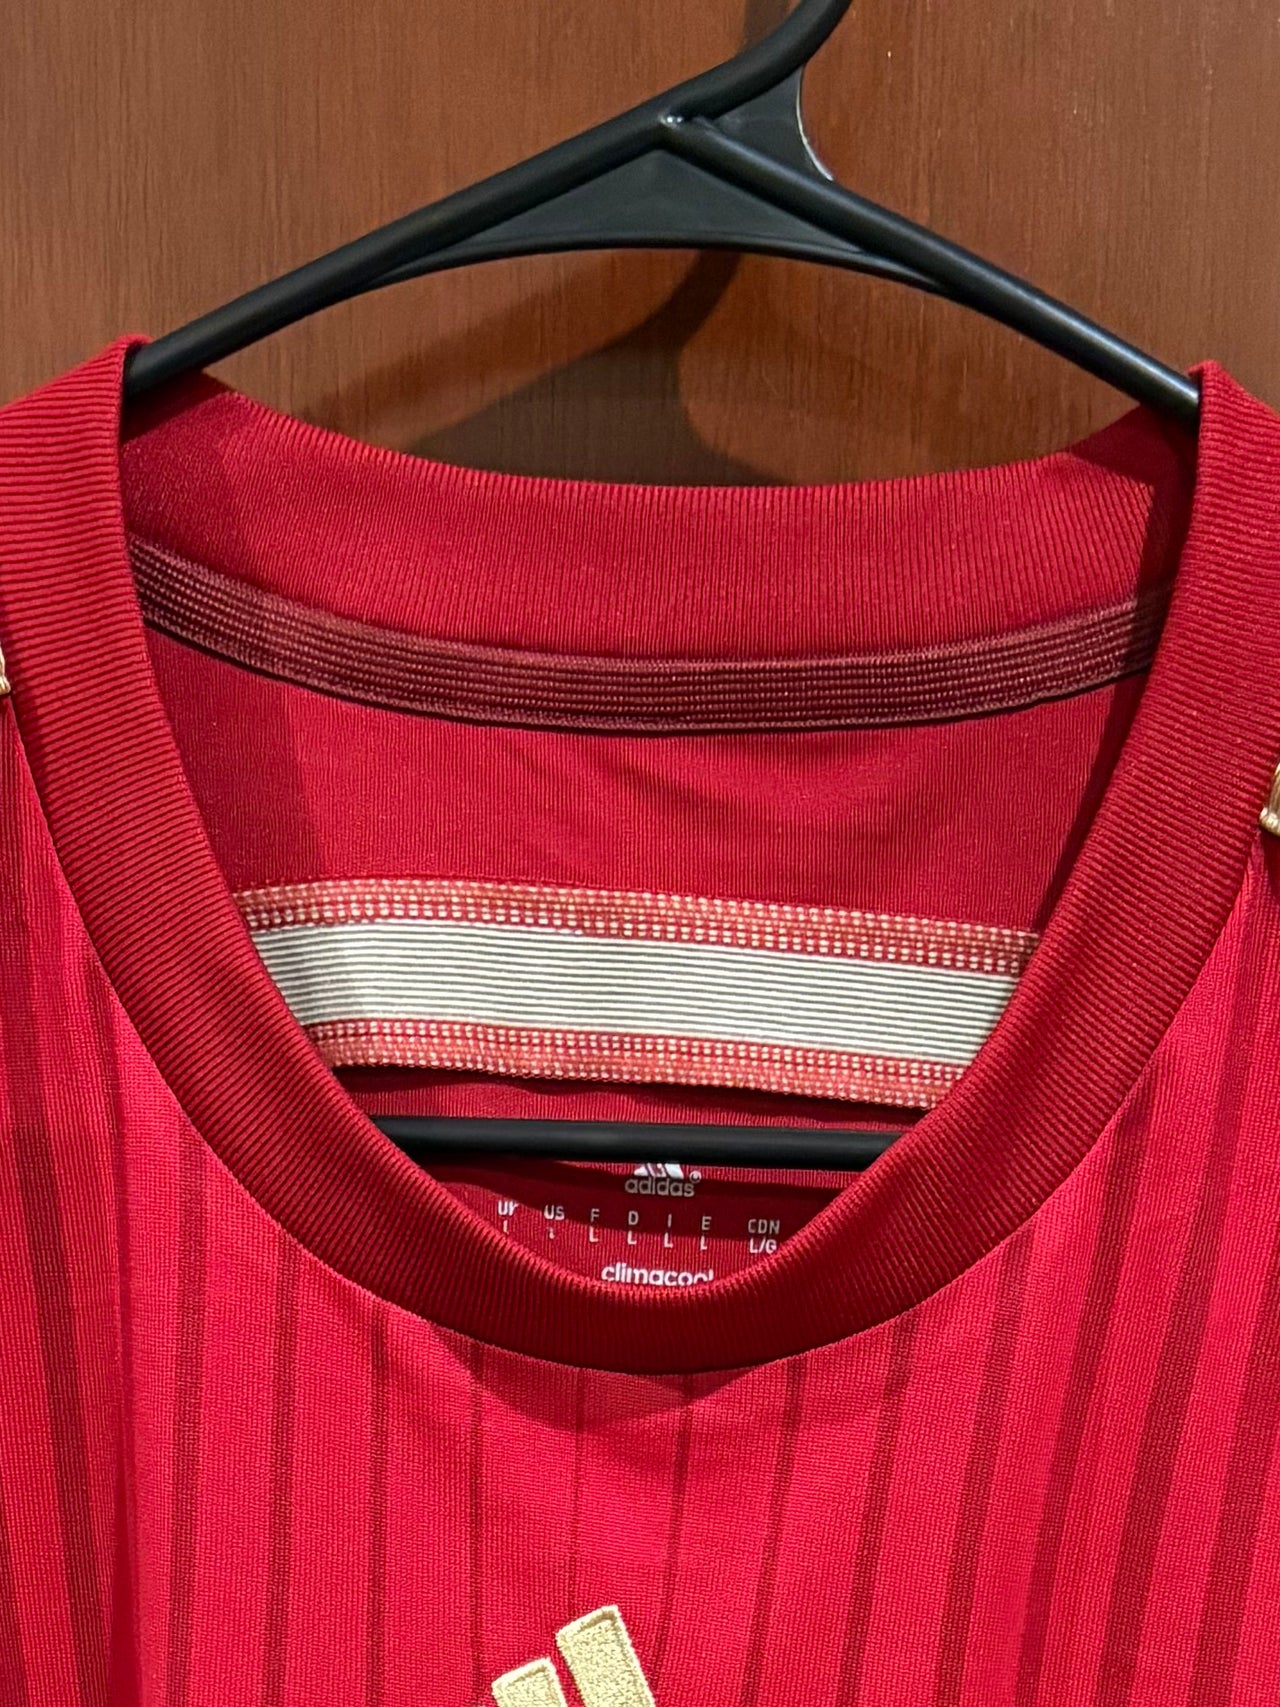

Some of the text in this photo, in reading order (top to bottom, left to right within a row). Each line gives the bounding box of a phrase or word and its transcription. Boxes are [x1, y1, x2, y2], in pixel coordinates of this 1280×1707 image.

[624, 1177, 695, 1198] adidas
[543, 1204, 565, 1220] US
[590, 1208, 600, 1223] F
[628, 1210, 639, 1226] D
[701, 1216, 713, 1231] E
[747, 1218, 781, 1235] CDN
[588, 1226, 599, 1243] L
[627, 1230, 637, 1245] L
[664, 1232, 674, 1249] L
[700, 1235, 708, 1251] L
